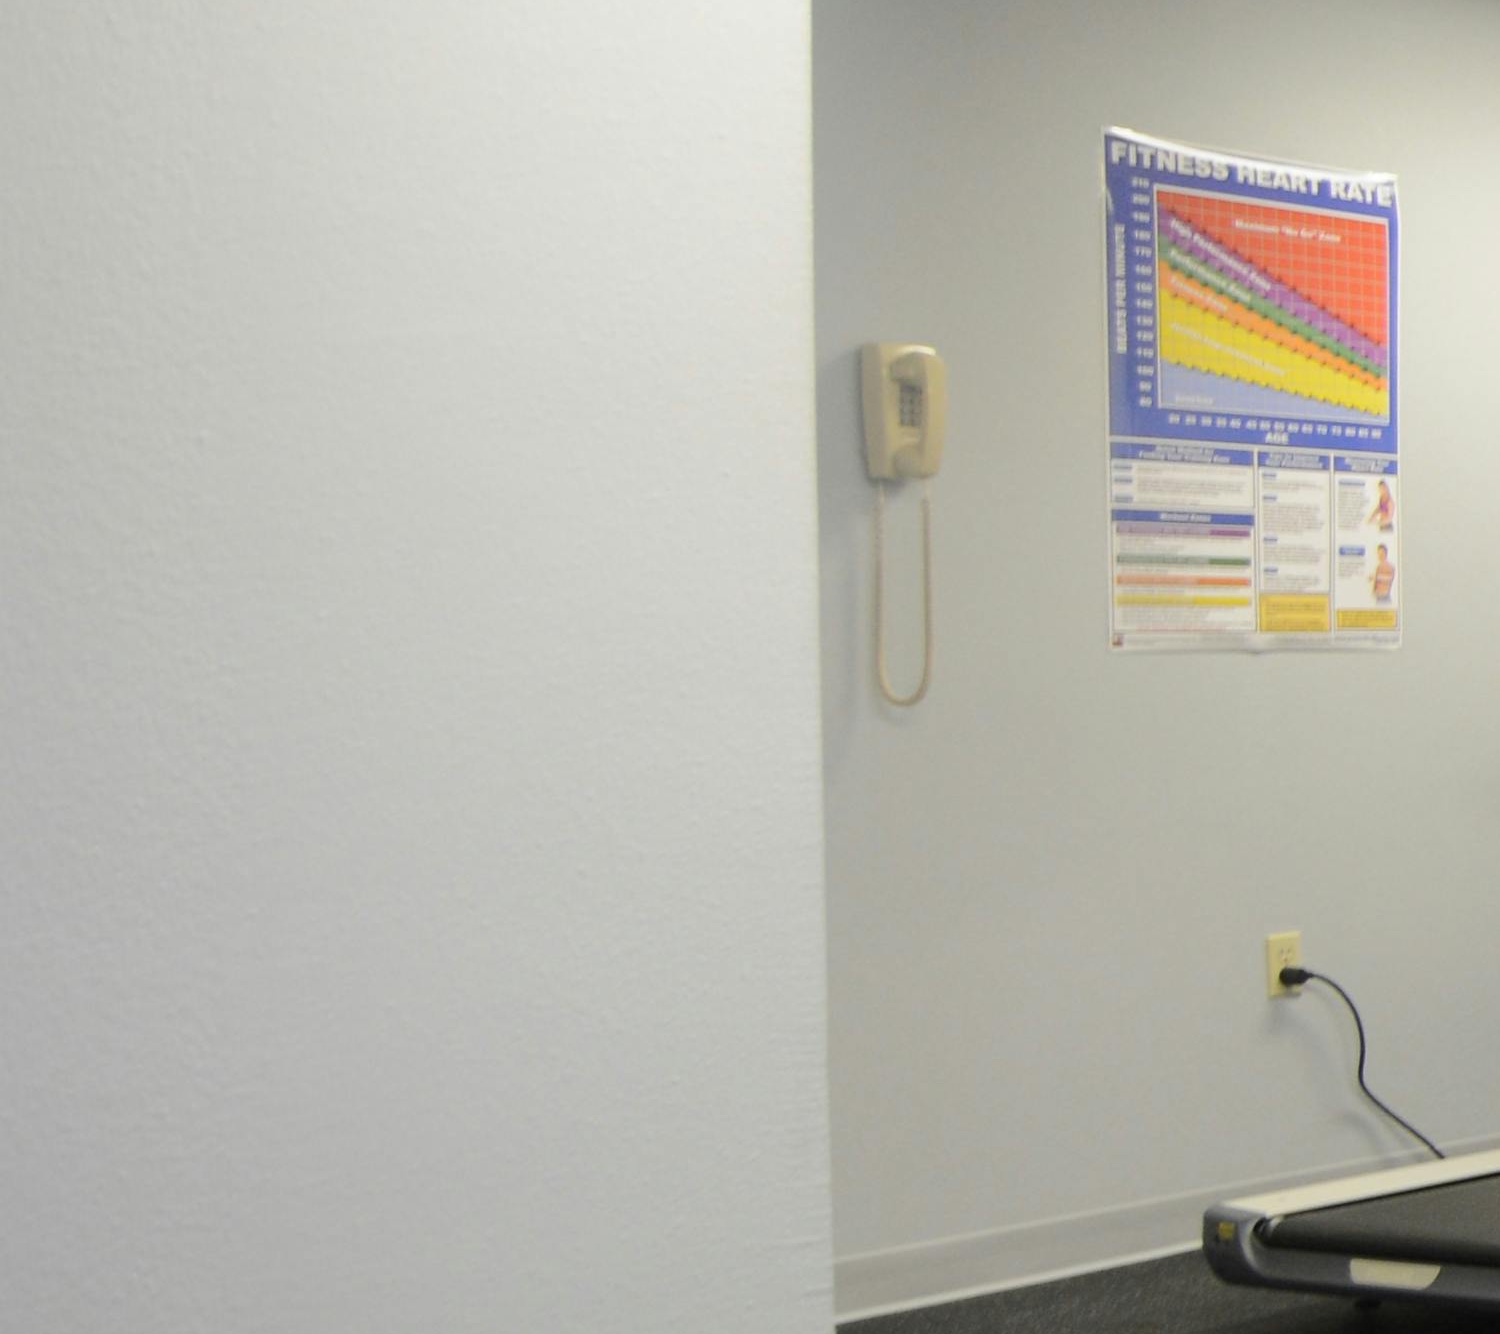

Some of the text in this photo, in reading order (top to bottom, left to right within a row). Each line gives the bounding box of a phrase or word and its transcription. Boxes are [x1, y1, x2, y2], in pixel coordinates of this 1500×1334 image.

[1111, 139, 1393, 209] FITNESS HEART RATE
